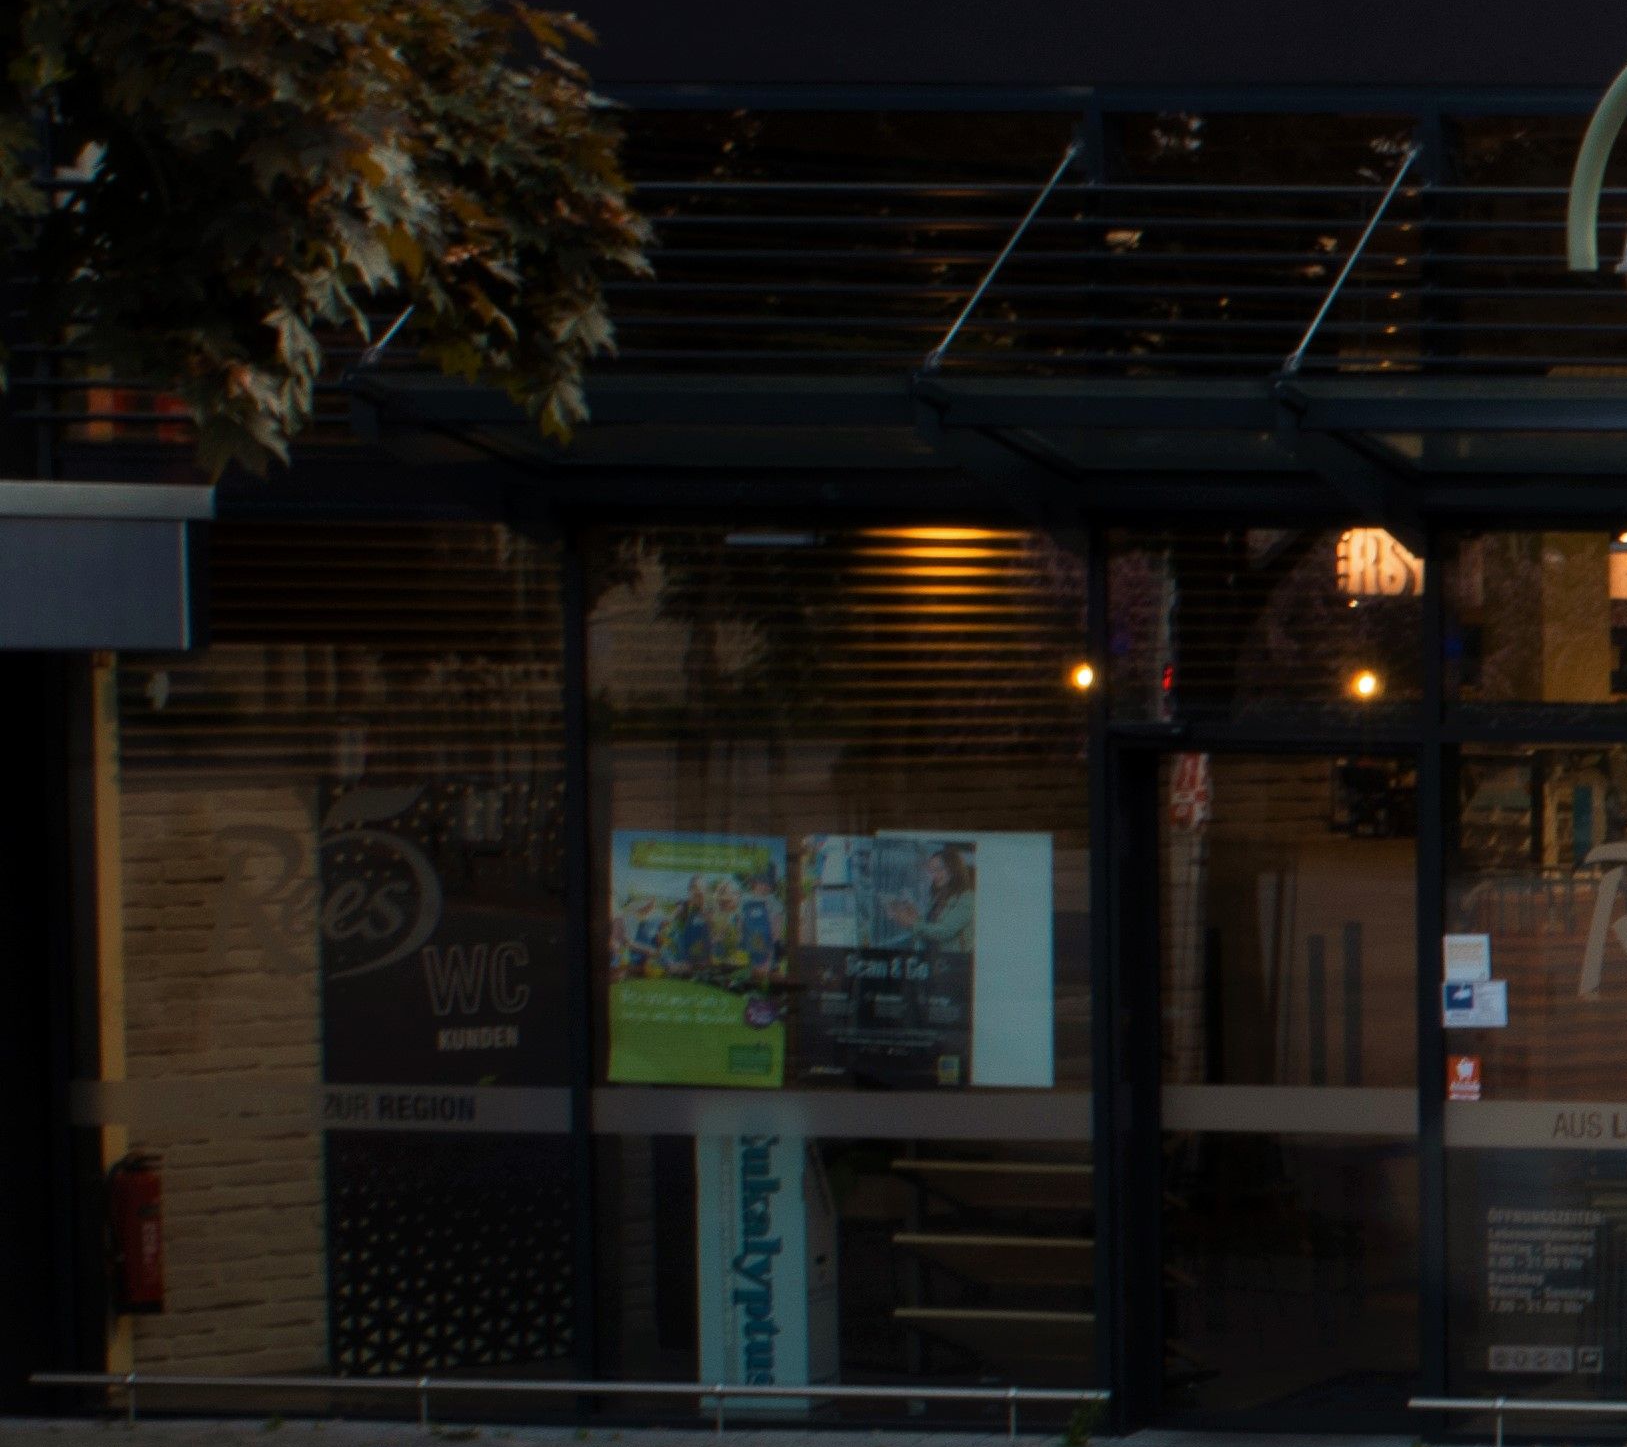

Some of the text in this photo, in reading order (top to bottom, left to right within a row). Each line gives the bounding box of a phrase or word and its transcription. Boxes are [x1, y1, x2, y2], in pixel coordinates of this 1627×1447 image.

[421, 941, 532, 1017] WC
[436, 1024, 520, 1052] KUNDEN
[375, 1094, 476, 1122] REGION
[1552, 1111, 1602, 1140] AUS
